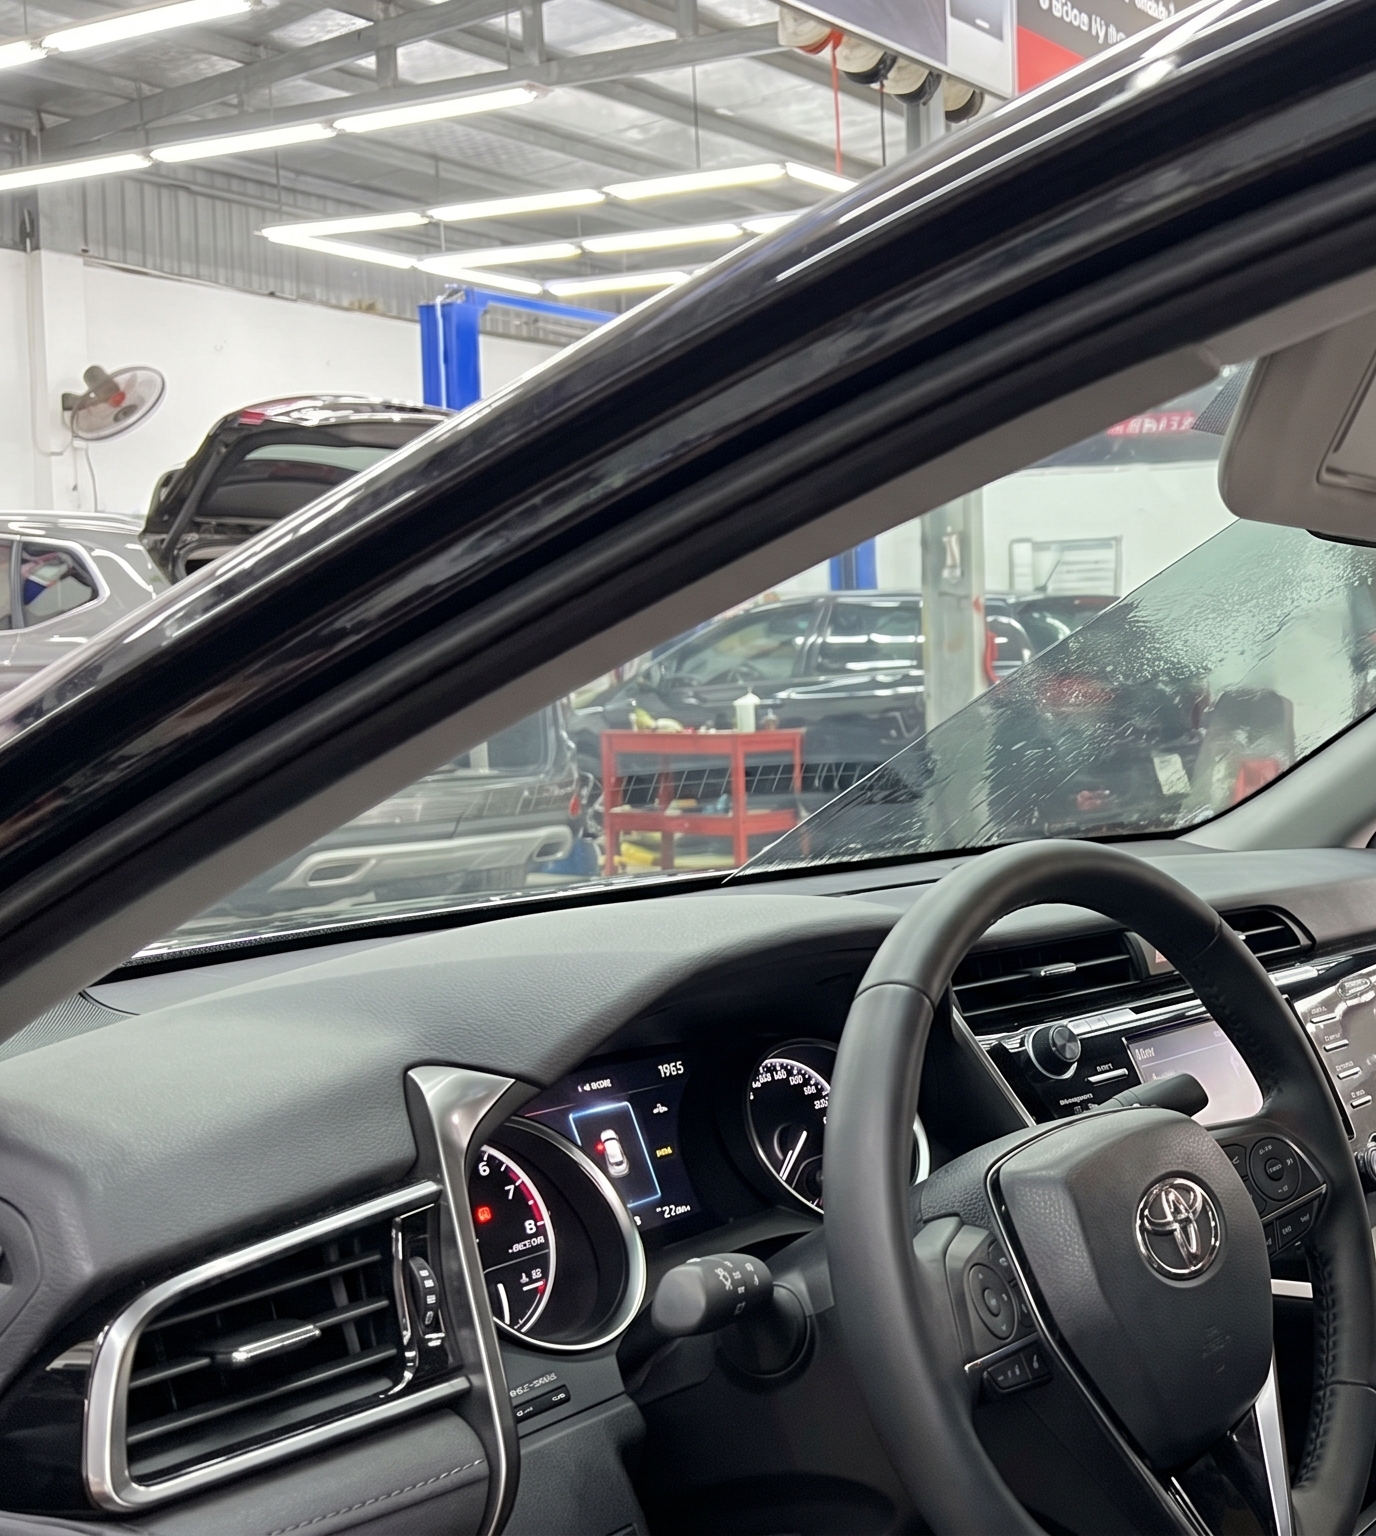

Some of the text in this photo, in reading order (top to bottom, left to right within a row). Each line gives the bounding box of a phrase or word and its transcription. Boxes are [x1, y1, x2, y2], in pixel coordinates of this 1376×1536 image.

[657, 1060, 684, 1078] 1965
[478, 1161, 490, 1176] 6
[504, 1184, 515, 1200] 7
[524, 1219, 537, 1234] 8
